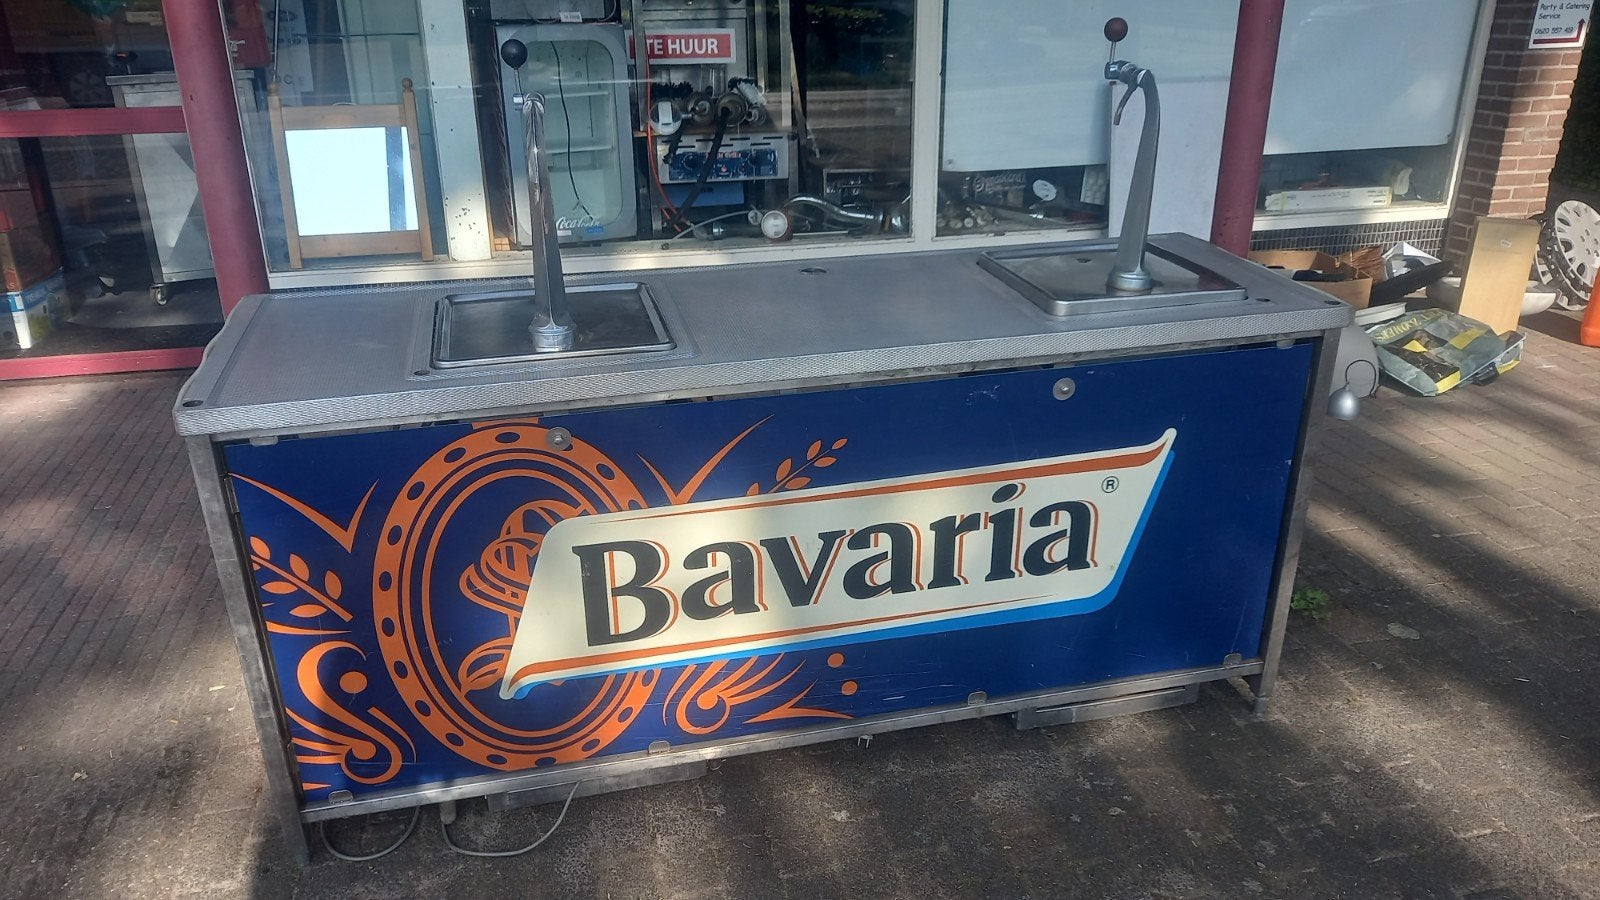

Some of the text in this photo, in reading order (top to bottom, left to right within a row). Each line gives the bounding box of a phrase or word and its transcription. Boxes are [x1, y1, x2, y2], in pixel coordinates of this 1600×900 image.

[1540, 3, 1557, 11] Party
[646, 38, 719, 55] TE HUUR
[571, 483, 1099, 647] Bavaria
